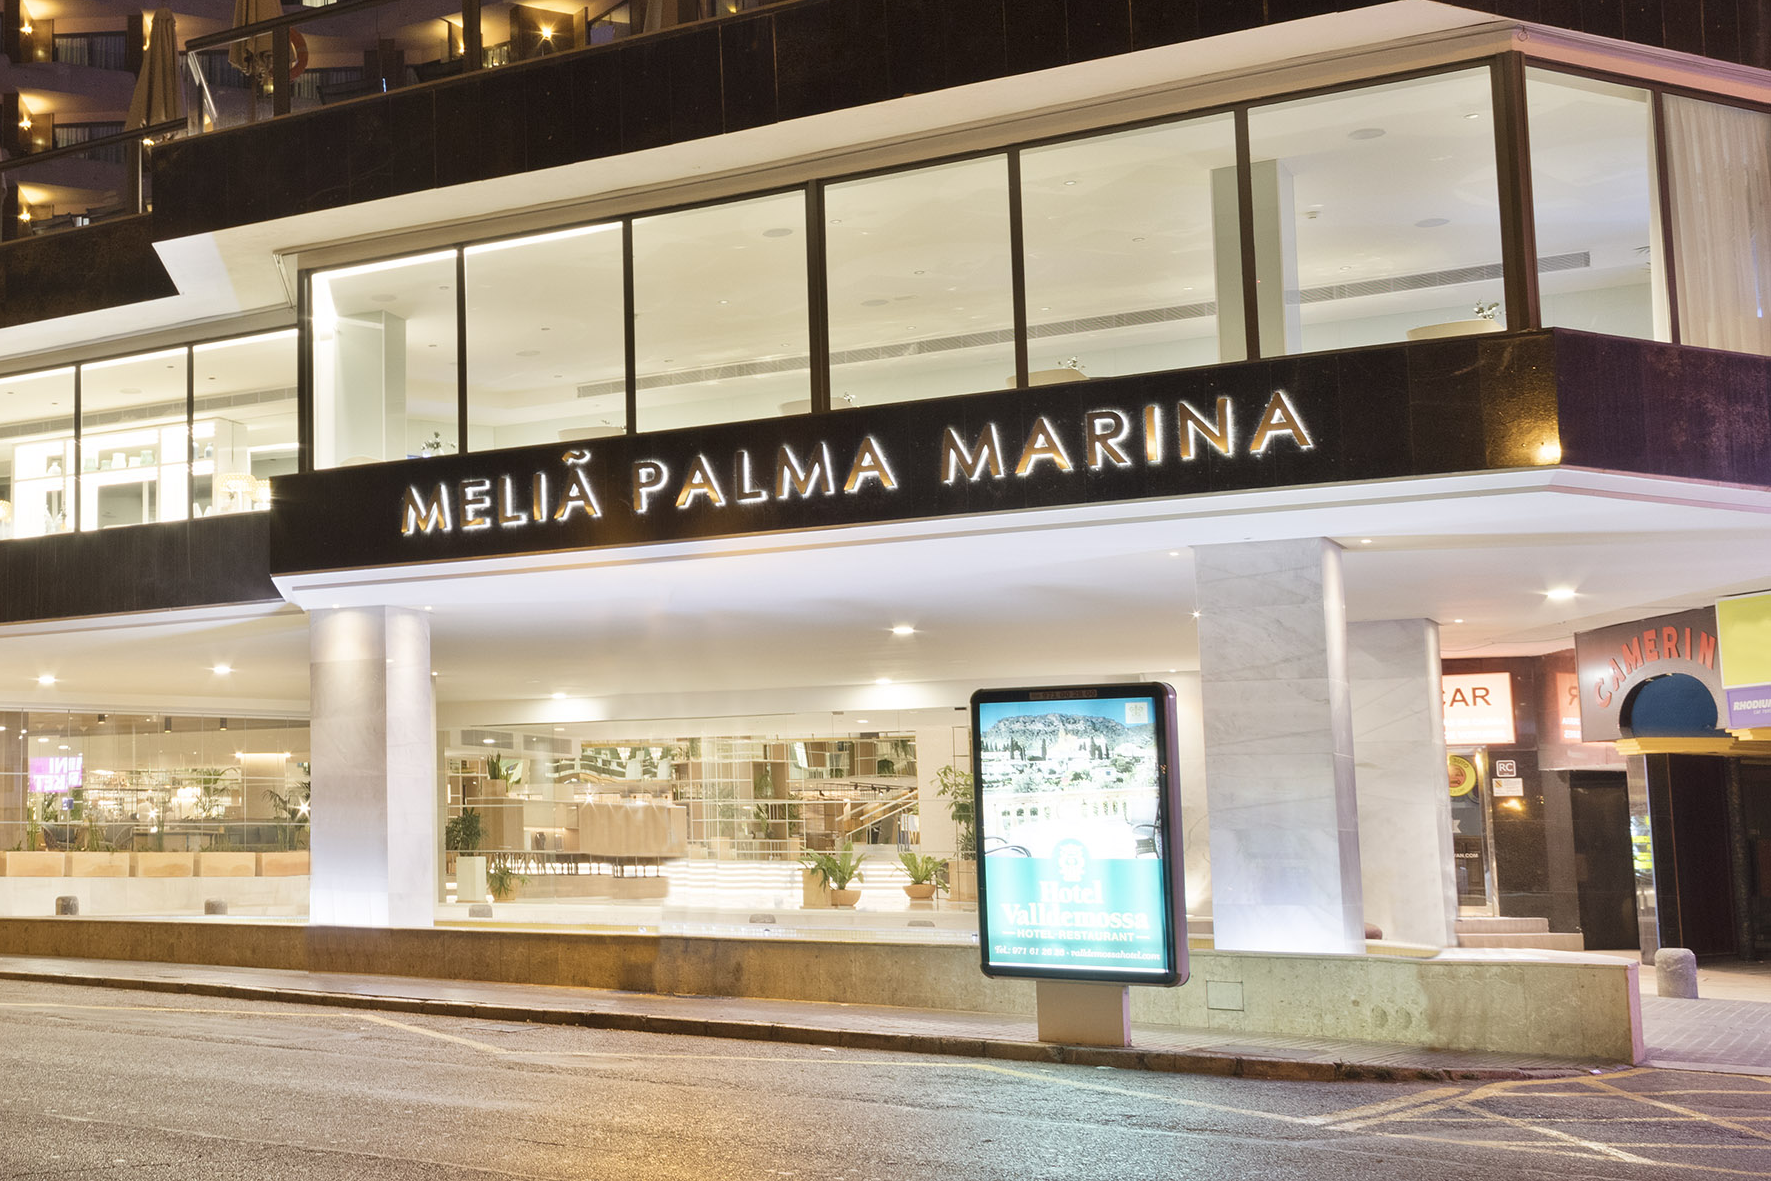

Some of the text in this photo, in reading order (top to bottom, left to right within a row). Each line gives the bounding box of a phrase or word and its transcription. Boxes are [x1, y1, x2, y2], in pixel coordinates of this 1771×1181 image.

[399, 389, 1315, 537] MELIÃ PALMA MARINA
[1594, 626, 1716, 707] CAMERIN
[1499, 763, 1514, 772] RC
[1039, 880, 1104, 904] Hotel
[1001, 902, 1150, 930] Valldemossa
[1012, 947, 1027, 955] 971
